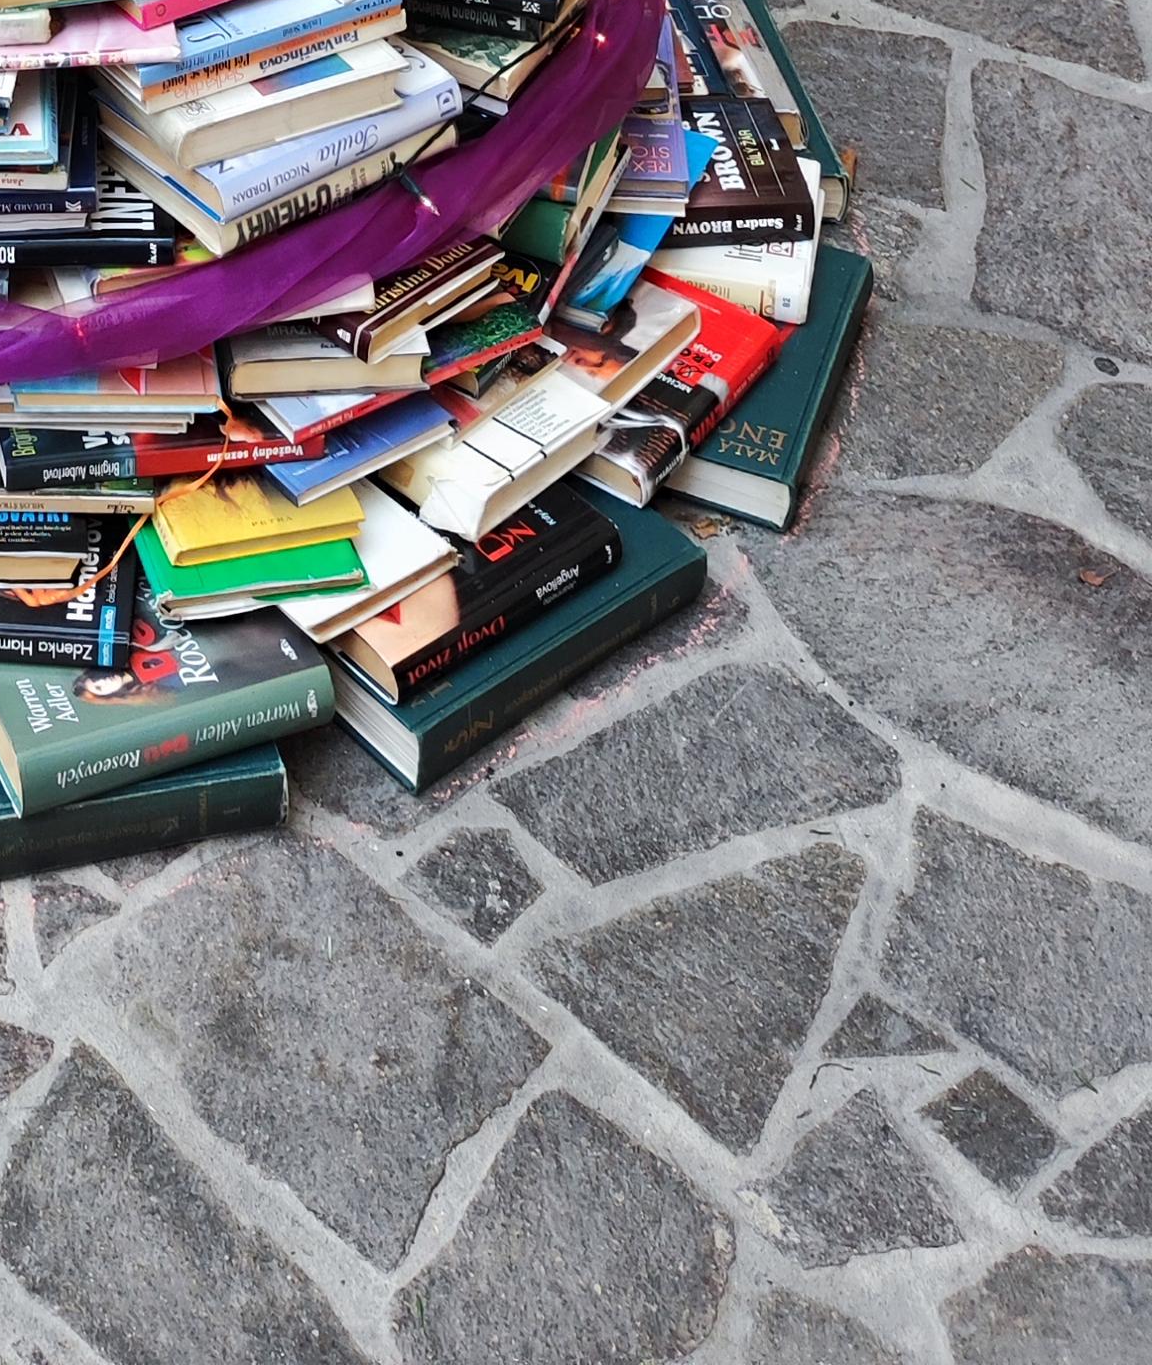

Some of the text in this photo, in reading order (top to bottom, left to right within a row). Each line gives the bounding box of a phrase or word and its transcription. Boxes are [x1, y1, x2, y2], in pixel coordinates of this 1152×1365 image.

[260, 30, 360, 70] Fan Vavřincová
[315, 124, 379, 166] Touha
[21, 201, 53, 214] EDUARD
[673, 217, 783, 237] Sandra BROWN
[42, 459, 120, 482] Brigitte Aubertová
[38, 638, 93, 661] Zdenka
[56, 701, 301, 786] Warren Roseových
